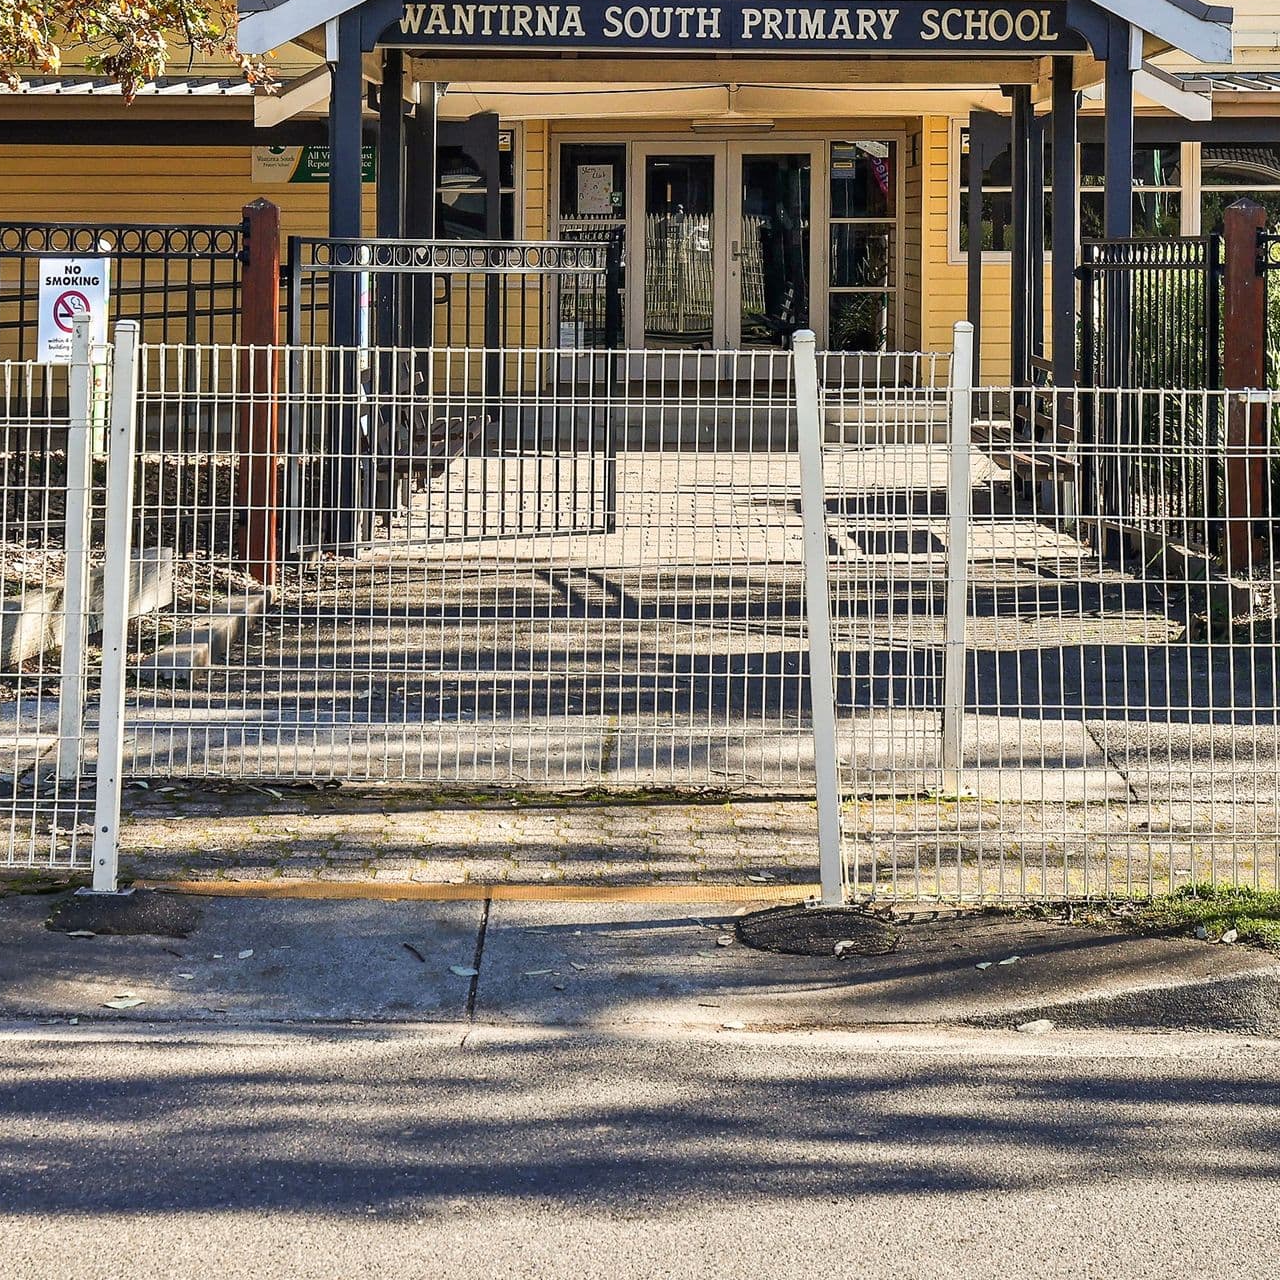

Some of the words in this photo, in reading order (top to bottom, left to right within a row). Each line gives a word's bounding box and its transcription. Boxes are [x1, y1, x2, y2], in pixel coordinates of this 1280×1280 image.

[399, 3, 586, 37] WANTIRNA
[603, 5, 722, 38] SOUTH
[741, 7, 900, 41] PRIMARY
[920, 8, 1059, 42] SCHOOL
[308, 151, 319, 160] All
[64, 265, 81, 275] NO
[45, 276, 100, 286] SMOKING
